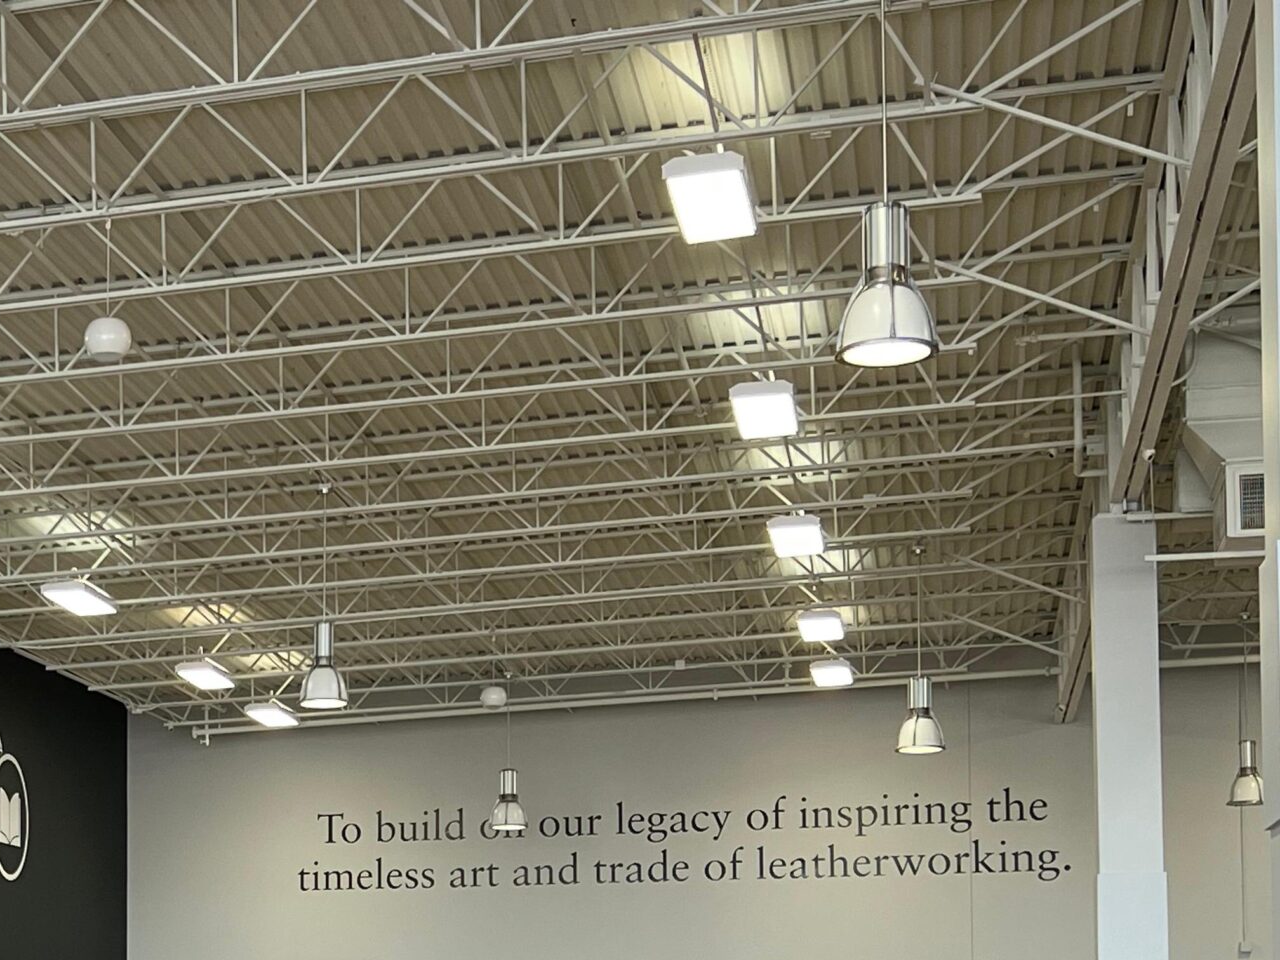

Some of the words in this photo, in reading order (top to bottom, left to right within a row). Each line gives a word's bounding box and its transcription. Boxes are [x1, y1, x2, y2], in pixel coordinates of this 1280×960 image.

[317, 812, 362, 844] To
[376, 808, 466, 843] build
[539, 814, 602, 838] our
[616, 801, 732, 843] legacy
[747, 795, 787, 830] of
[799, 792, 972, 837] inspiring
[987, 787, 1049, 822] the
[298, 856, 435, 891] timeless
[450, 863, 500, 888] art
[513, 852, 581, 887] and
[594, 849, 690, 884] trade
[705, 846, 745, 882] of
[757, 838, 1072, 881] leatherworking.
